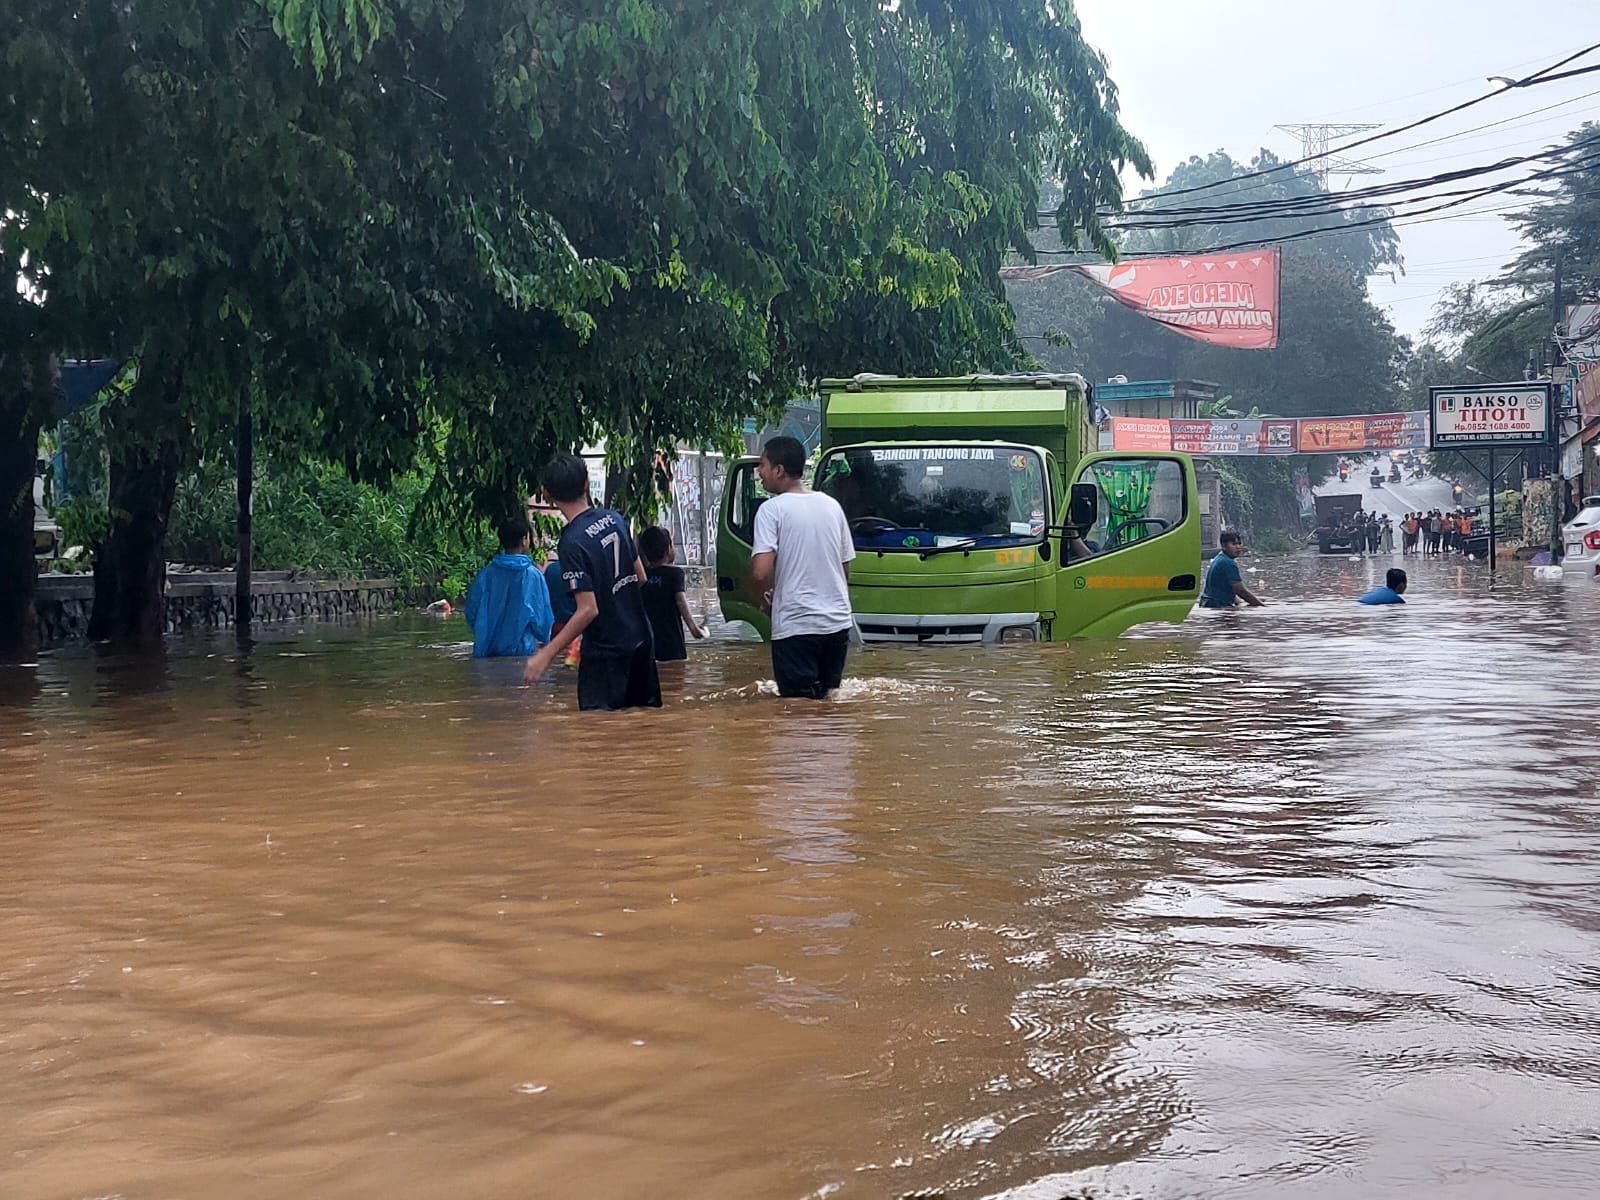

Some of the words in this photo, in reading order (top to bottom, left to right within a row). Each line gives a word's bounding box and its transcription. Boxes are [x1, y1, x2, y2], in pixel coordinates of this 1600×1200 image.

[1463, 395, 1519, 408] BAKSO
[1459, 408, 1527, 422] TITOTI
[871, 450, 920, 461] BANGUN
[922, 449, 969, 461] TANJONG
[970, 448, 995, 460] JAYA
[600, 531, 620, 579] 7
[562, 571, 585, 580] GOAT
